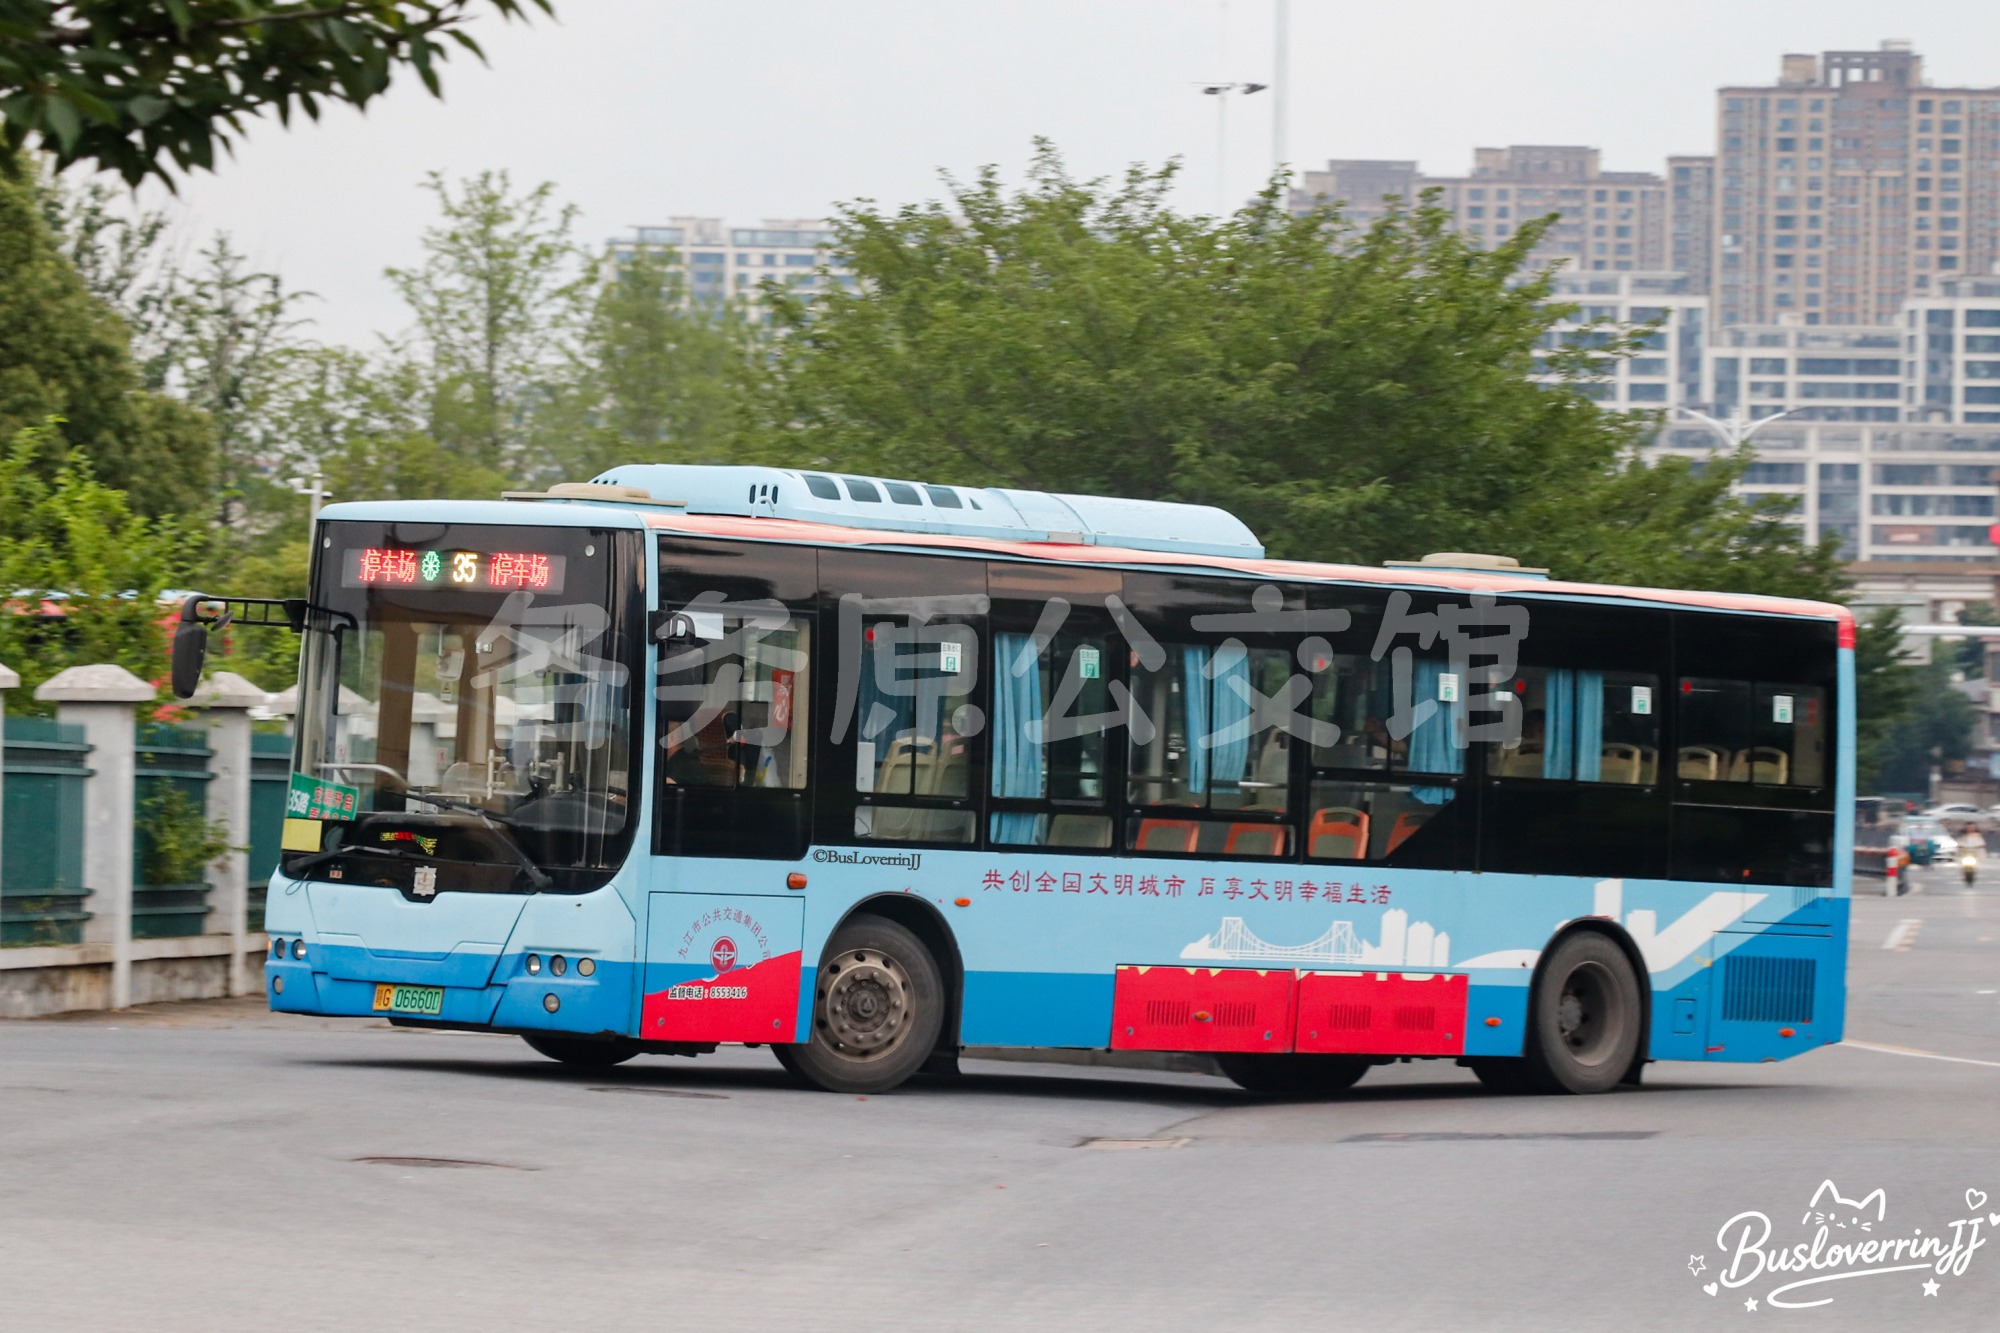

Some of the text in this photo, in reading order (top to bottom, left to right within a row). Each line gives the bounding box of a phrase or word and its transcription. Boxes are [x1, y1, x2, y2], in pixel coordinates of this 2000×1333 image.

[360, 549, 549, 587] 停车场 35 停车场
[982, 869, 1186, 898] 共创全国文明城市
[678, 907, 771, 959] 九江市公共交通集团公司
